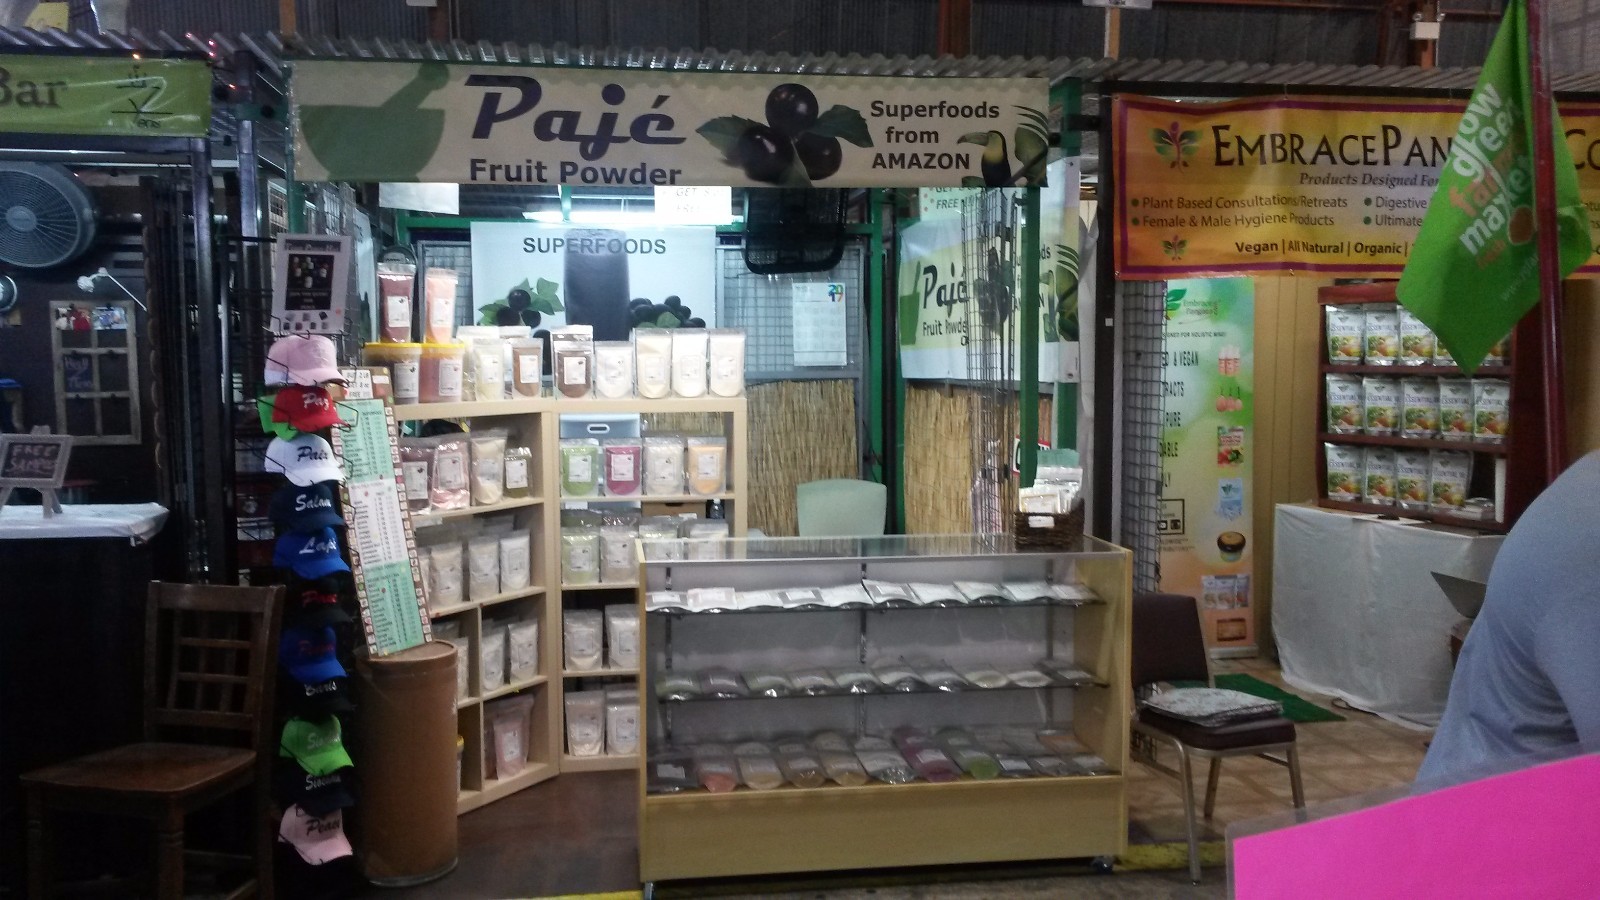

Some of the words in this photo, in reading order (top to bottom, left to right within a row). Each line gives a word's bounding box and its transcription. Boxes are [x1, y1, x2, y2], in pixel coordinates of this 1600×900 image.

[464, 74, 687, 161] Pajé
[870, 100, 1000, 122] Superfoods
[885, 126, 939, 144] from
[872, 153, 970, 170] AMAZON
[470, 159, 548, 183] Fruit
[560, 161, 682, 185] Powder
[1300, 172, 1358, 186] Products
[1361, 172, 1419, 190] Designed
[936, 198, 959, 210] FREE
[1142, 197, 1173, 210] Plant
[1177, 197, 1213, 210] Based
[1375, 196, 1427, 211] Digestive
[1143, 214, 1186, 228] Female
[1189, 215, 1198, 227] &
[1201, 214, 1231, 227] Male
[1234, 212, 1288, 230] Hygiene
[1289, 213, 1335, 226] Products
[1375, 214, 1423, 227] Ultimate
[522, 237, 667, 255] SUPERFOODS
[1235, 241, 1279, 255] Vegan
[1288, 241, 1300, 253] All
[1302, 241, 1344, 254] Natural
[1354, 241, 1402, 256] Organic
[923, 319, 943, 337] Fruit
